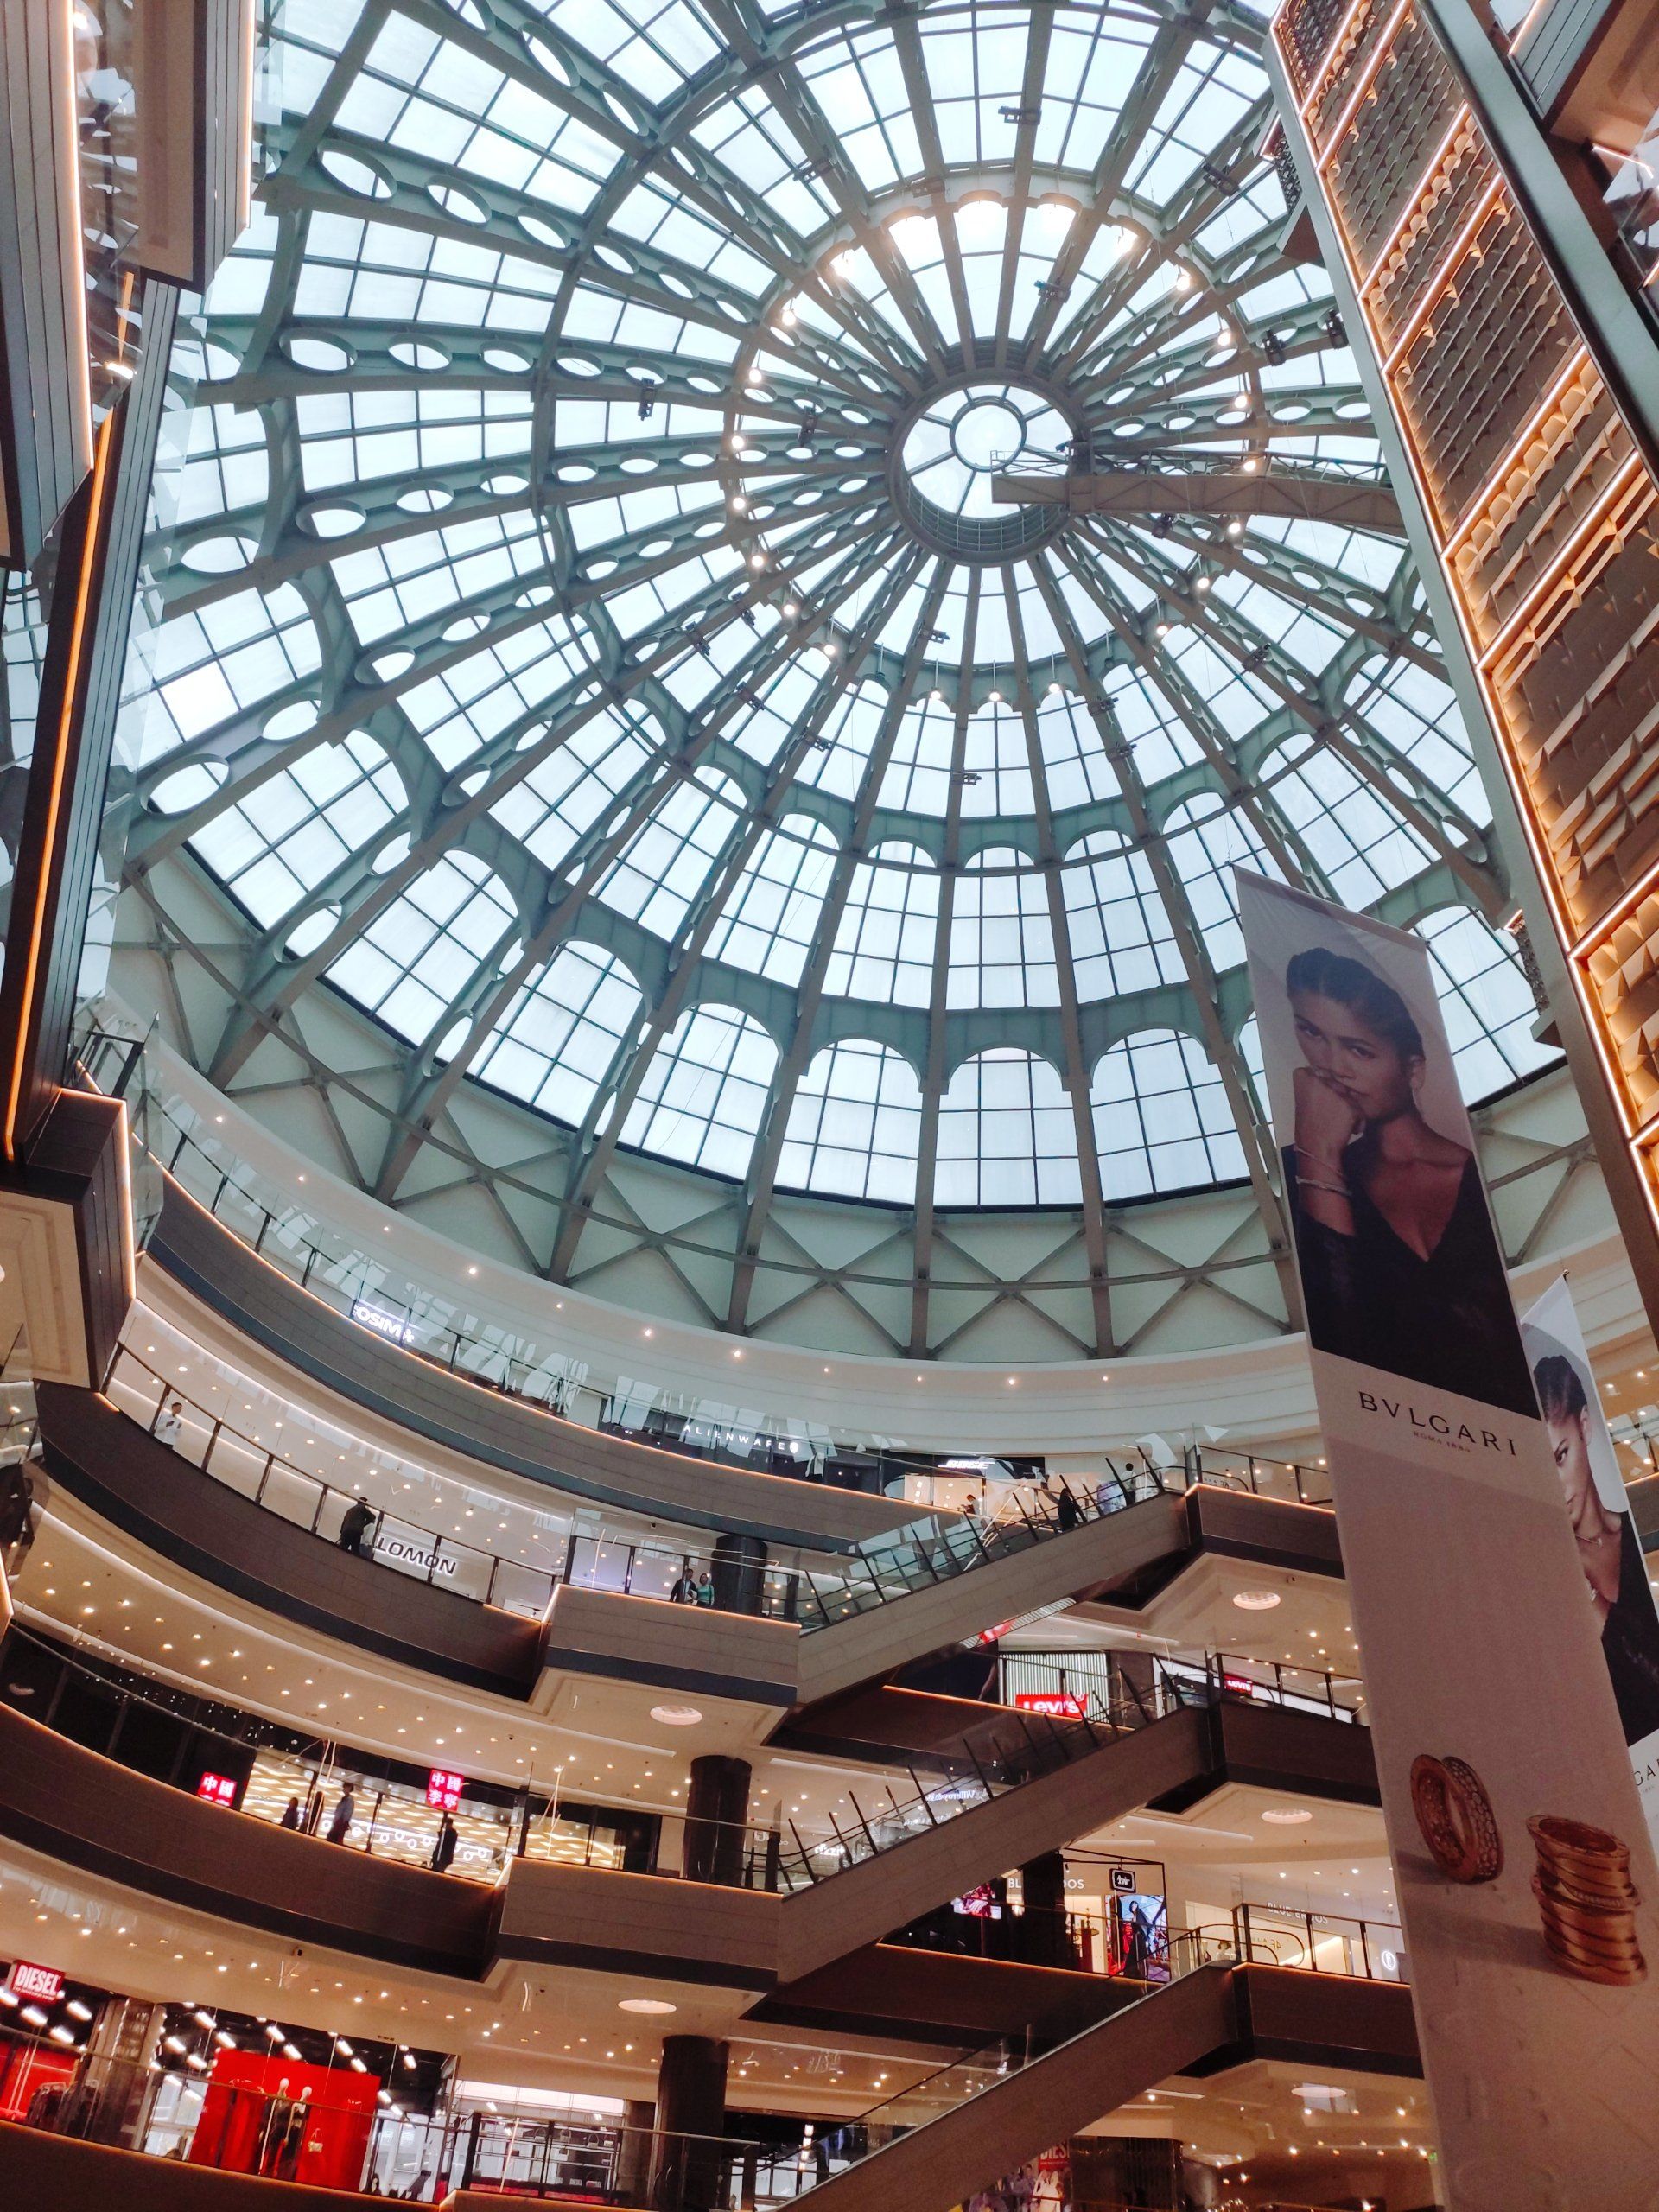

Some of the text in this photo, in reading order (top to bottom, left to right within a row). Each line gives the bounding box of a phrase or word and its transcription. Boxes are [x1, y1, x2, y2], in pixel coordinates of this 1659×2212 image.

[357, 1306, 402, 1338] OSIM
[683, 1424, 785, 1451] ALIENWARE
[1358, 1391, 1516, 1456] BVLGARI
[375, 1537, 456, 1574] LOMON
[14, 1965, 59, 1997] DIESEL
